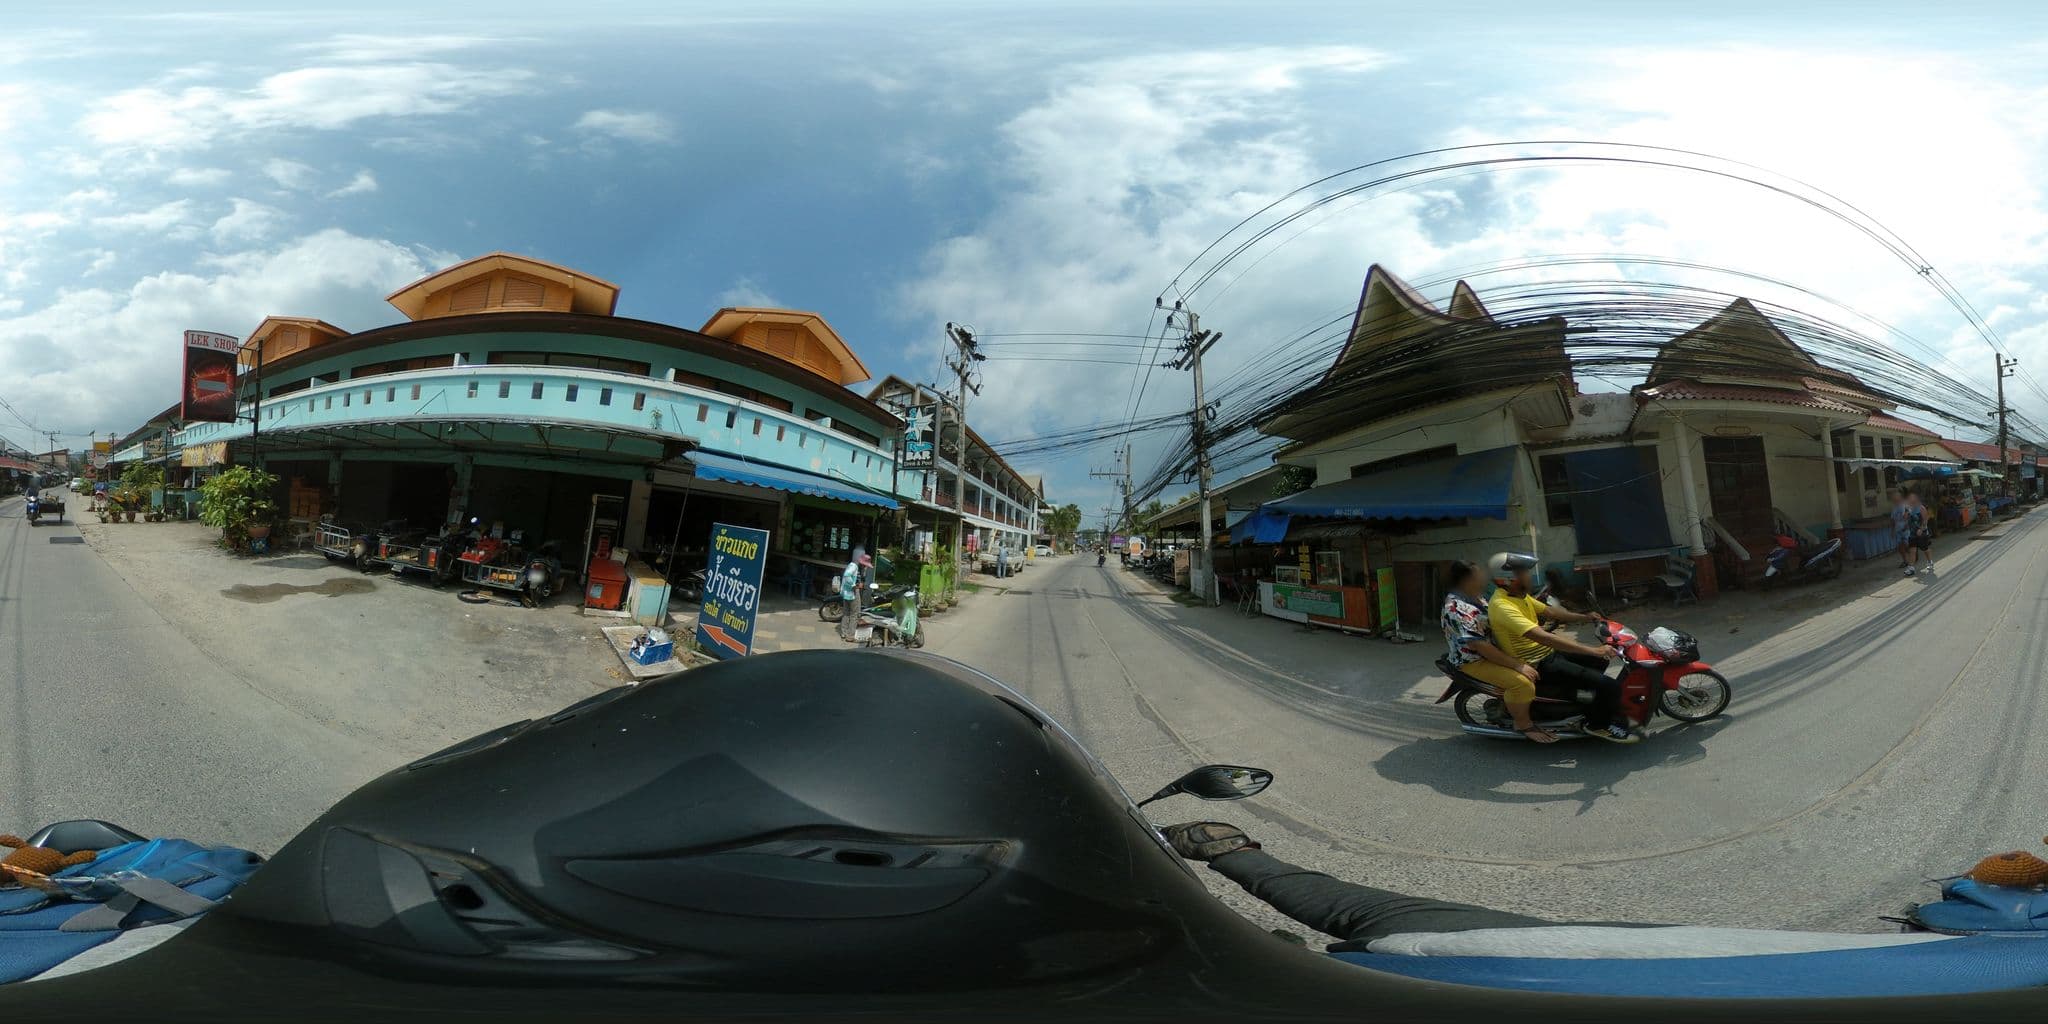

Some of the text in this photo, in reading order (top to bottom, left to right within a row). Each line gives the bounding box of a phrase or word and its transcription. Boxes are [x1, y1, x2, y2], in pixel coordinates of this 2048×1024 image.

[191, 333, 238, 351] LEK SHOP
[906, 450, 931, 460] BAR
[715, 528, 758, 560] ข้าวแกง
[706, 555, 757, 611] ป้าเขียว
